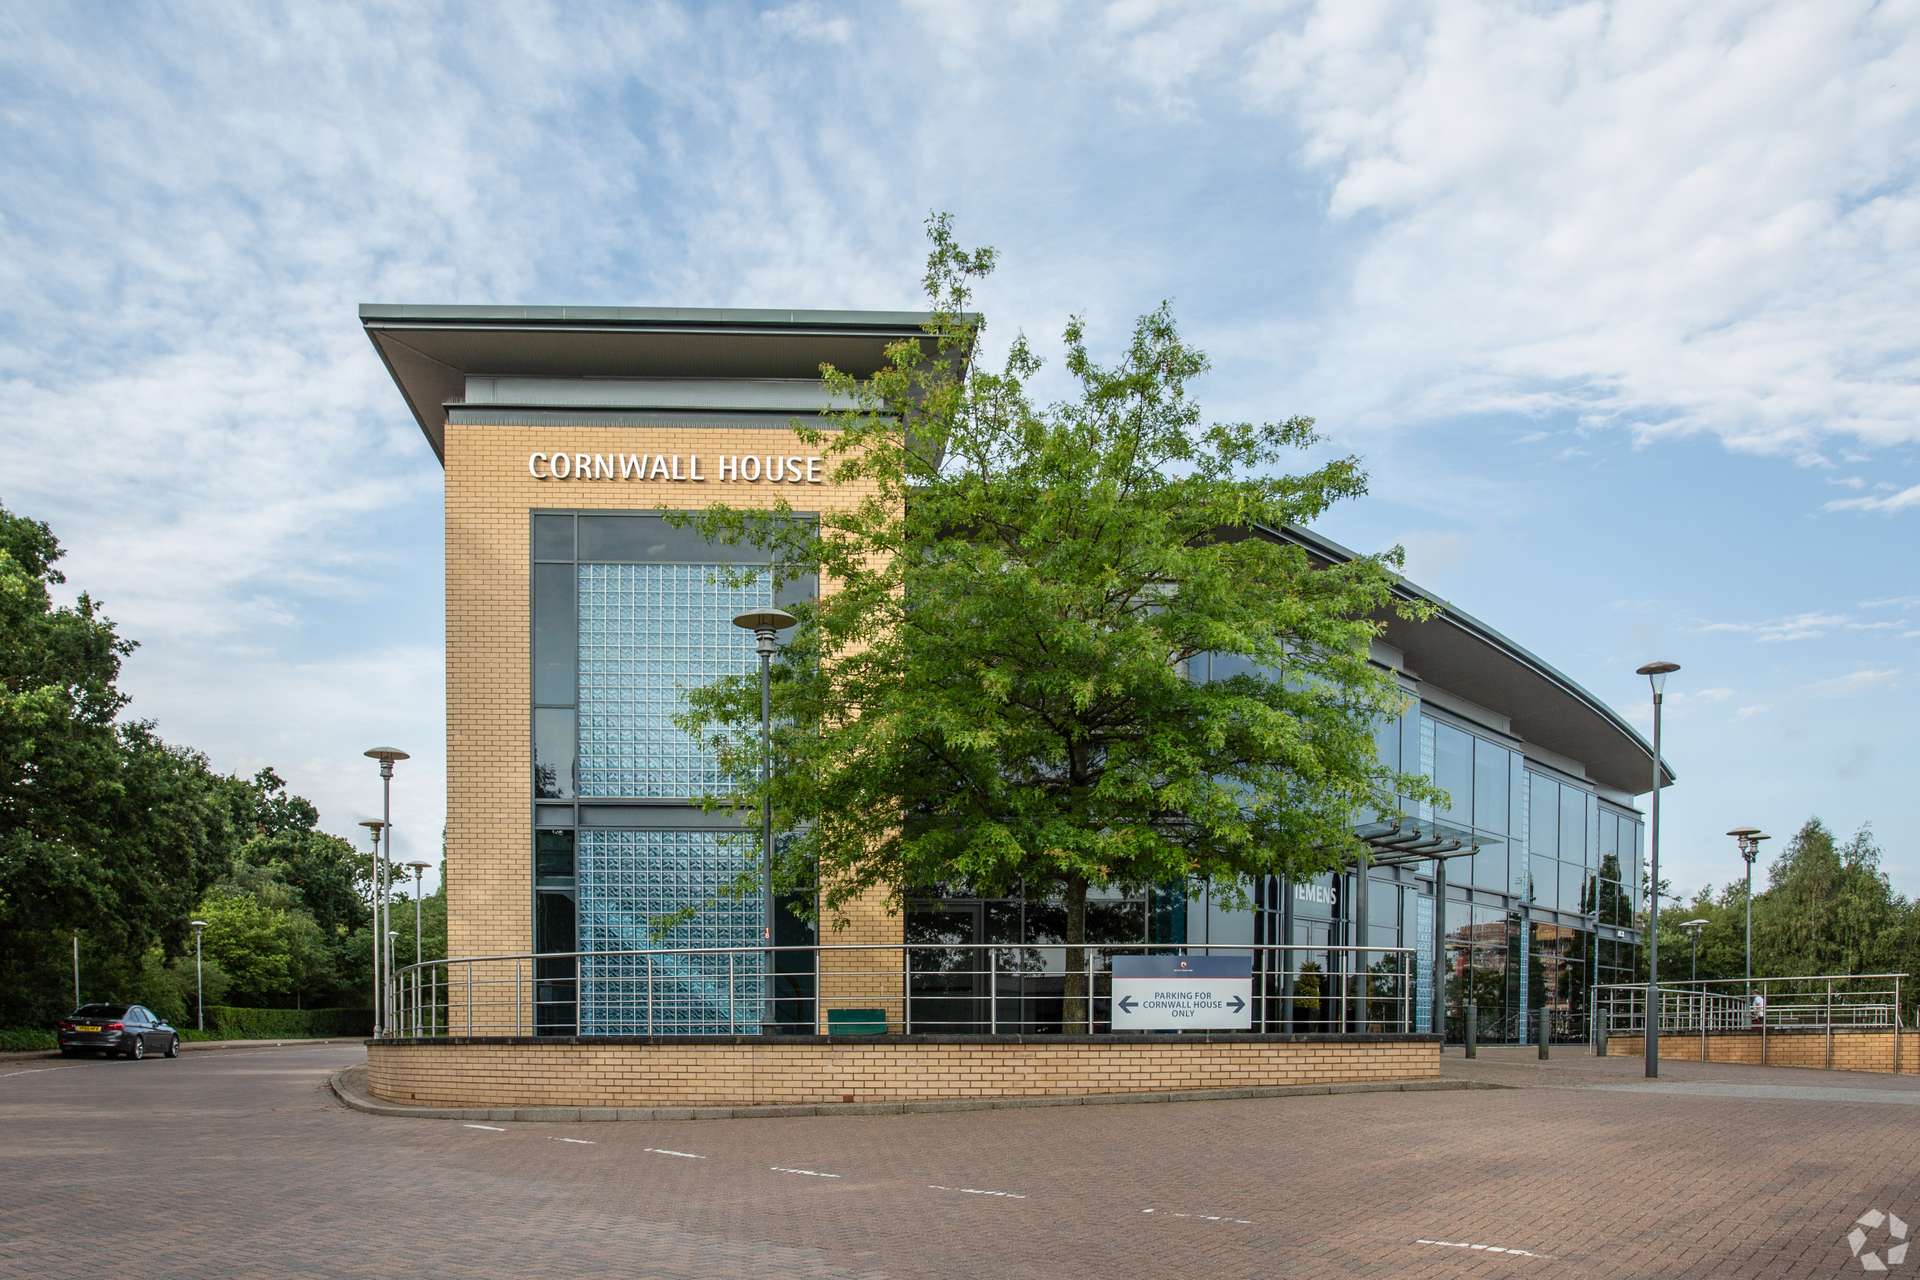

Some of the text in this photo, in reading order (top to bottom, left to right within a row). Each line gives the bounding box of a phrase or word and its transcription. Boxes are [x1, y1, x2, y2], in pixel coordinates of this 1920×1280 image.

[528, 451, 822, 484] CORNWALL HOUSE
[1295, 882, 1337, 905] IEMENS
[1154, 992, 1212, 1000] PARKING FOR
[1143, 1001, 1222, 1009] CORNWALL HOUSE
[1171, 1010, 1195, 1018] ONLY
